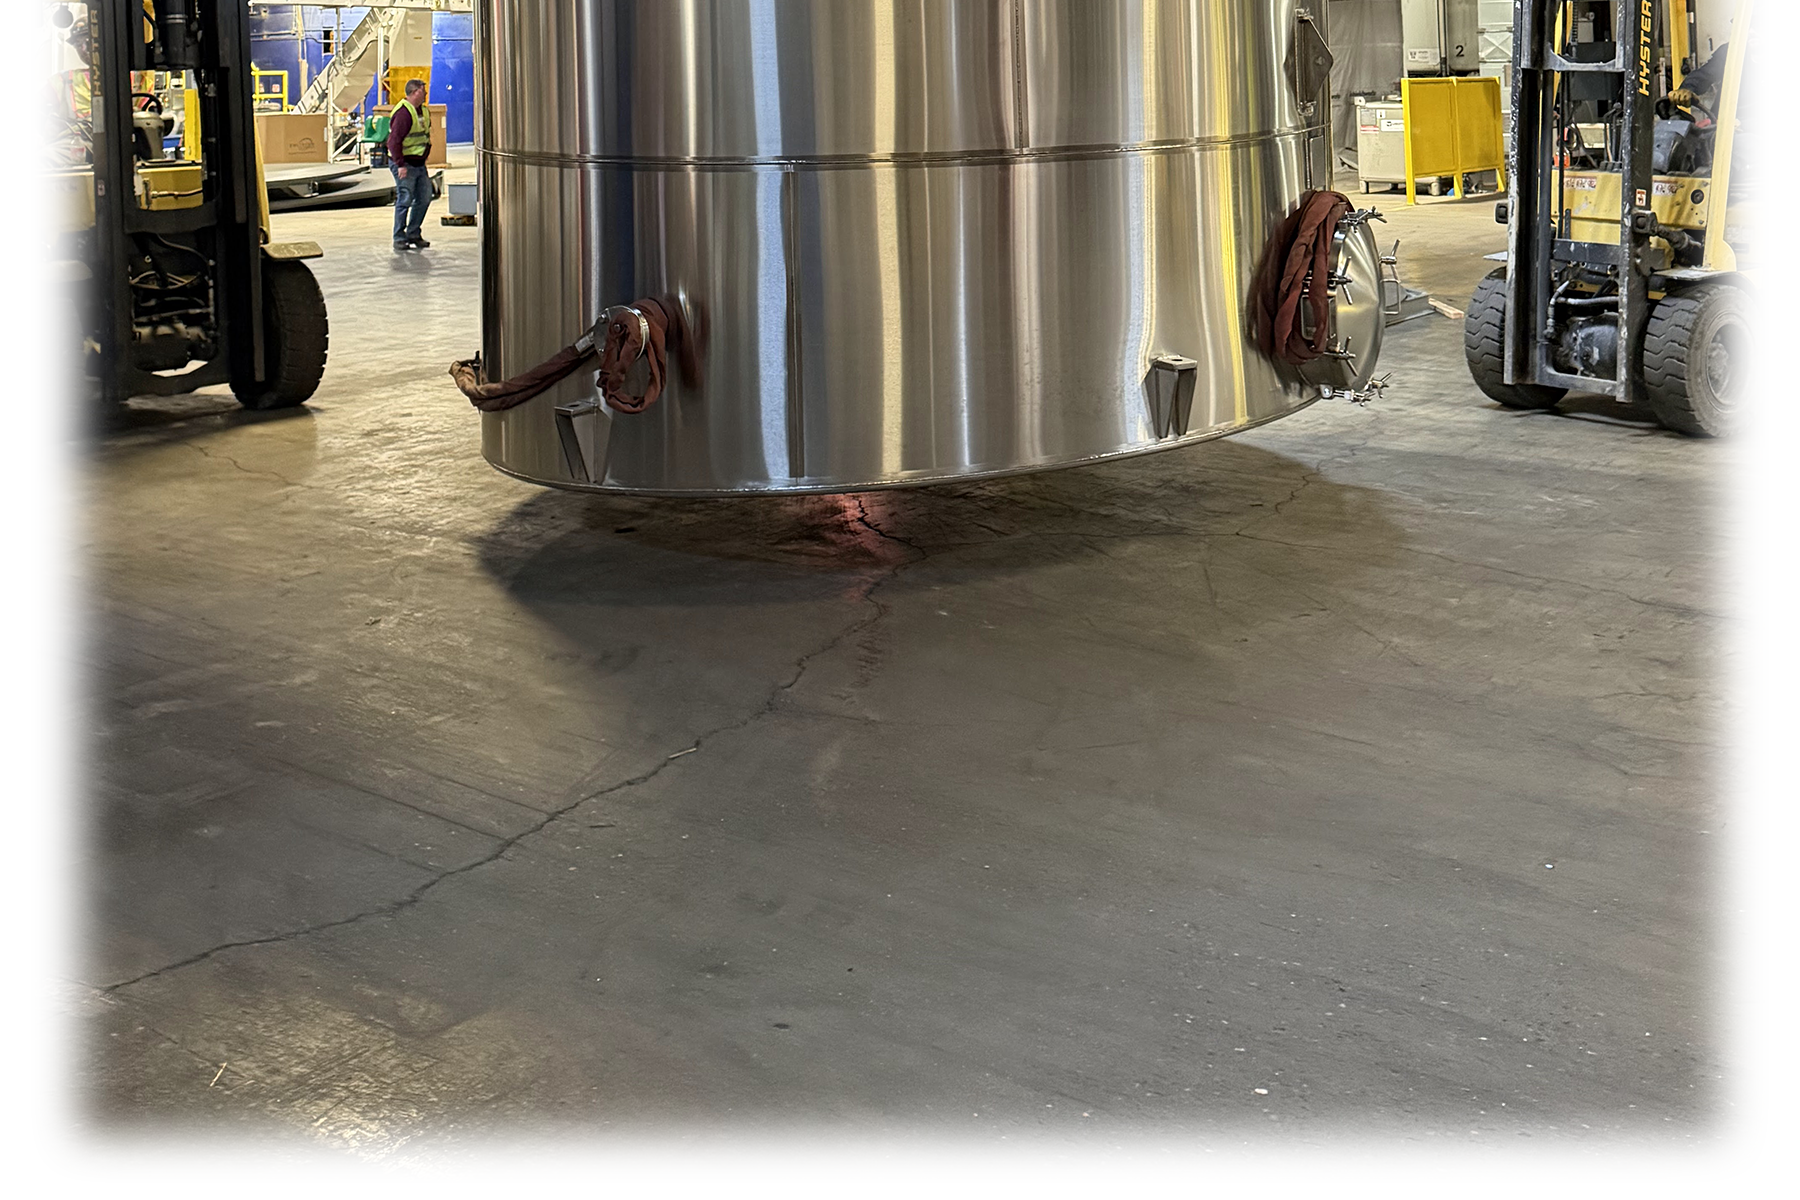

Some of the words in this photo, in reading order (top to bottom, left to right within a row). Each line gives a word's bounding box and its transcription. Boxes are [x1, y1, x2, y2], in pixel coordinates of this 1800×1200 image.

[90, 10, 101, 96] HYSTER
[1455, 45, 1465, 57] 2
[1638, 0, 1652, 97] HYSTER
